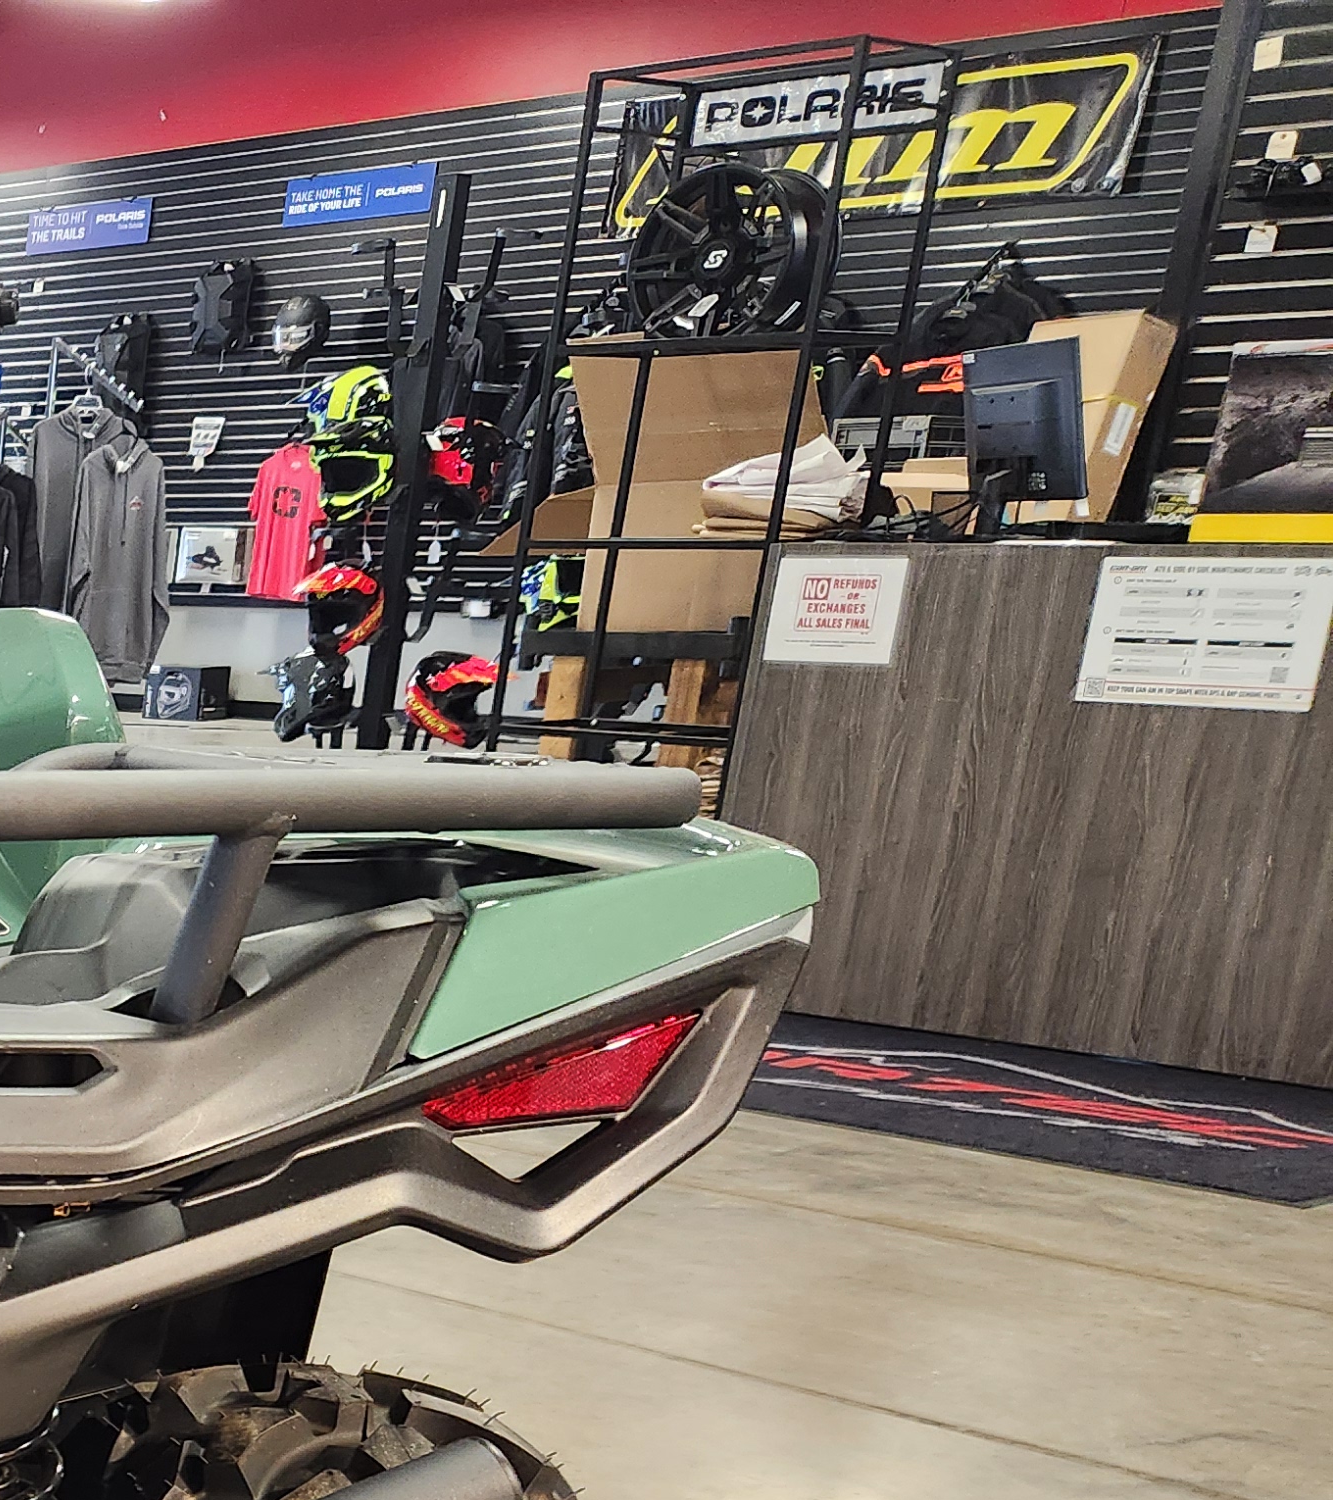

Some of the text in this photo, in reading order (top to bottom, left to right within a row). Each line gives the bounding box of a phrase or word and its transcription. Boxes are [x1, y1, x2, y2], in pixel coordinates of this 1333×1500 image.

[291, 184, 364, 203] TAKE HOME THE
[375, 184, 424, 198] POLARIS
[288, 197, 362, 215] RIDE OF YOUR LIFE
[34, 210, 88, 228] TIME TO HIT
[96, 210, 146, 225] POLARIS
[31, 227, 86, 244] THE TRAILS
[805, 578, 829, 600] NO
[833, 578, 878, 590] REFUNDS
[806, 602, 866, 614] EXCHANGES
[796, 617, 871, 630] ALL SALES FINAL
